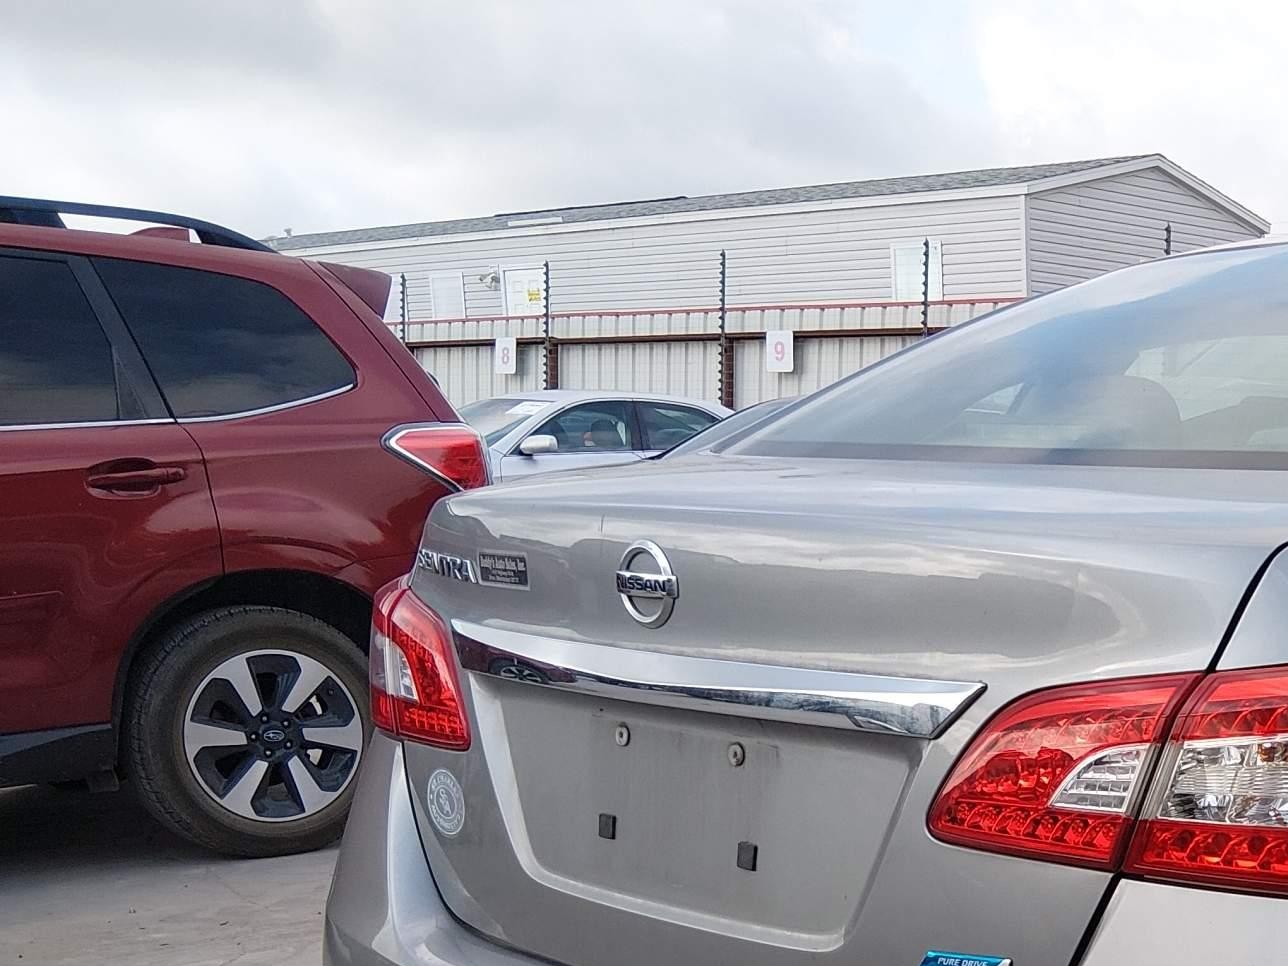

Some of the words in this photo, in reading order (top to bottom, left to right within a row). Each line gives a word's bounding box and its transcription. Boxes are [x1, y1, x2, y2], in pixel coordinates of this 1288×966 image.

[502, 346, 510, 365] 8
[774, 341, 785, 362] 9
[616, 572, 667, 593] NISSAN
[937, 957, 961, 966] PURE
